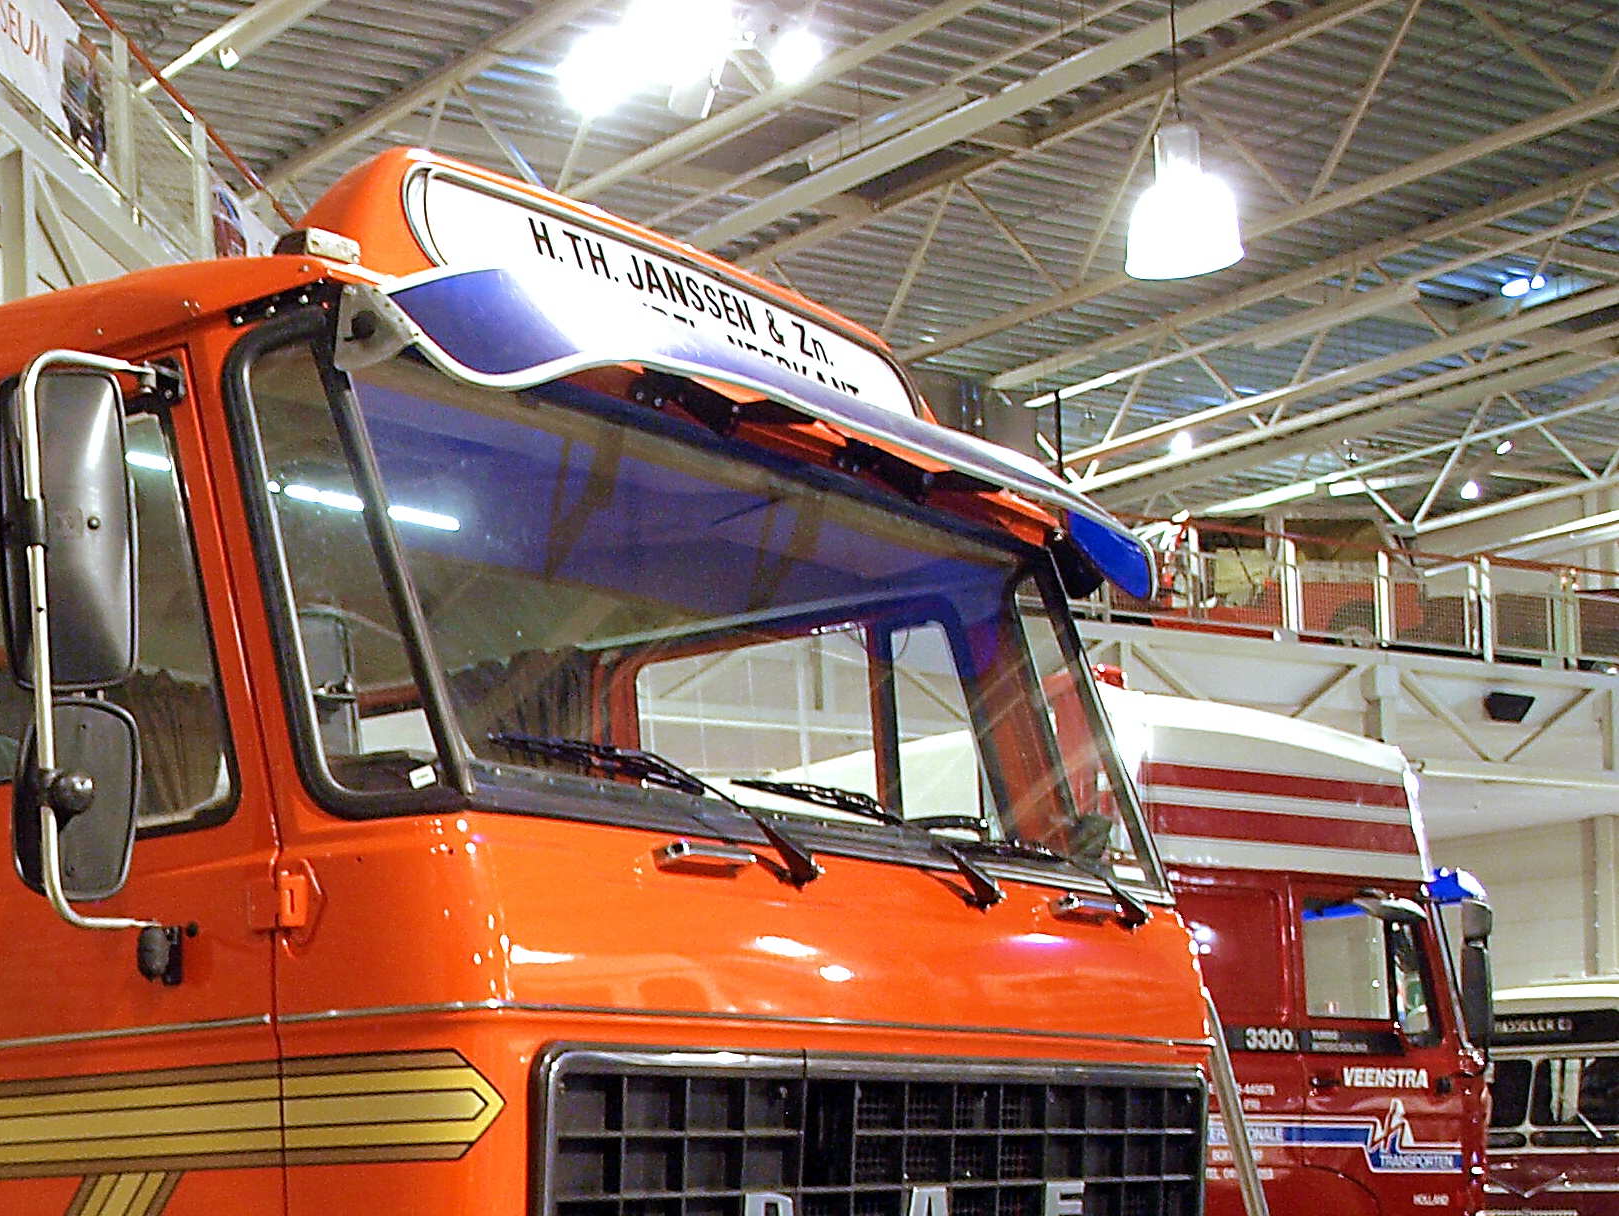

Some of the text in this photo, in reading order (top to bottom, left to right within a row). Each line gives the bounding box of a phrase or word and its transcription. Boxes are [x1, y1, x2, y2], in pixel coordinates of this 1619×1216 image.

[627, 253, 757, 335] JANSSEN
[765, 308, 785, 347] &
[791, 320, 834, 366] Zn.
[1245, 1027, 1294, 1050] 3300
[1342, 1066, 1429, 1089] VEENSTRA
